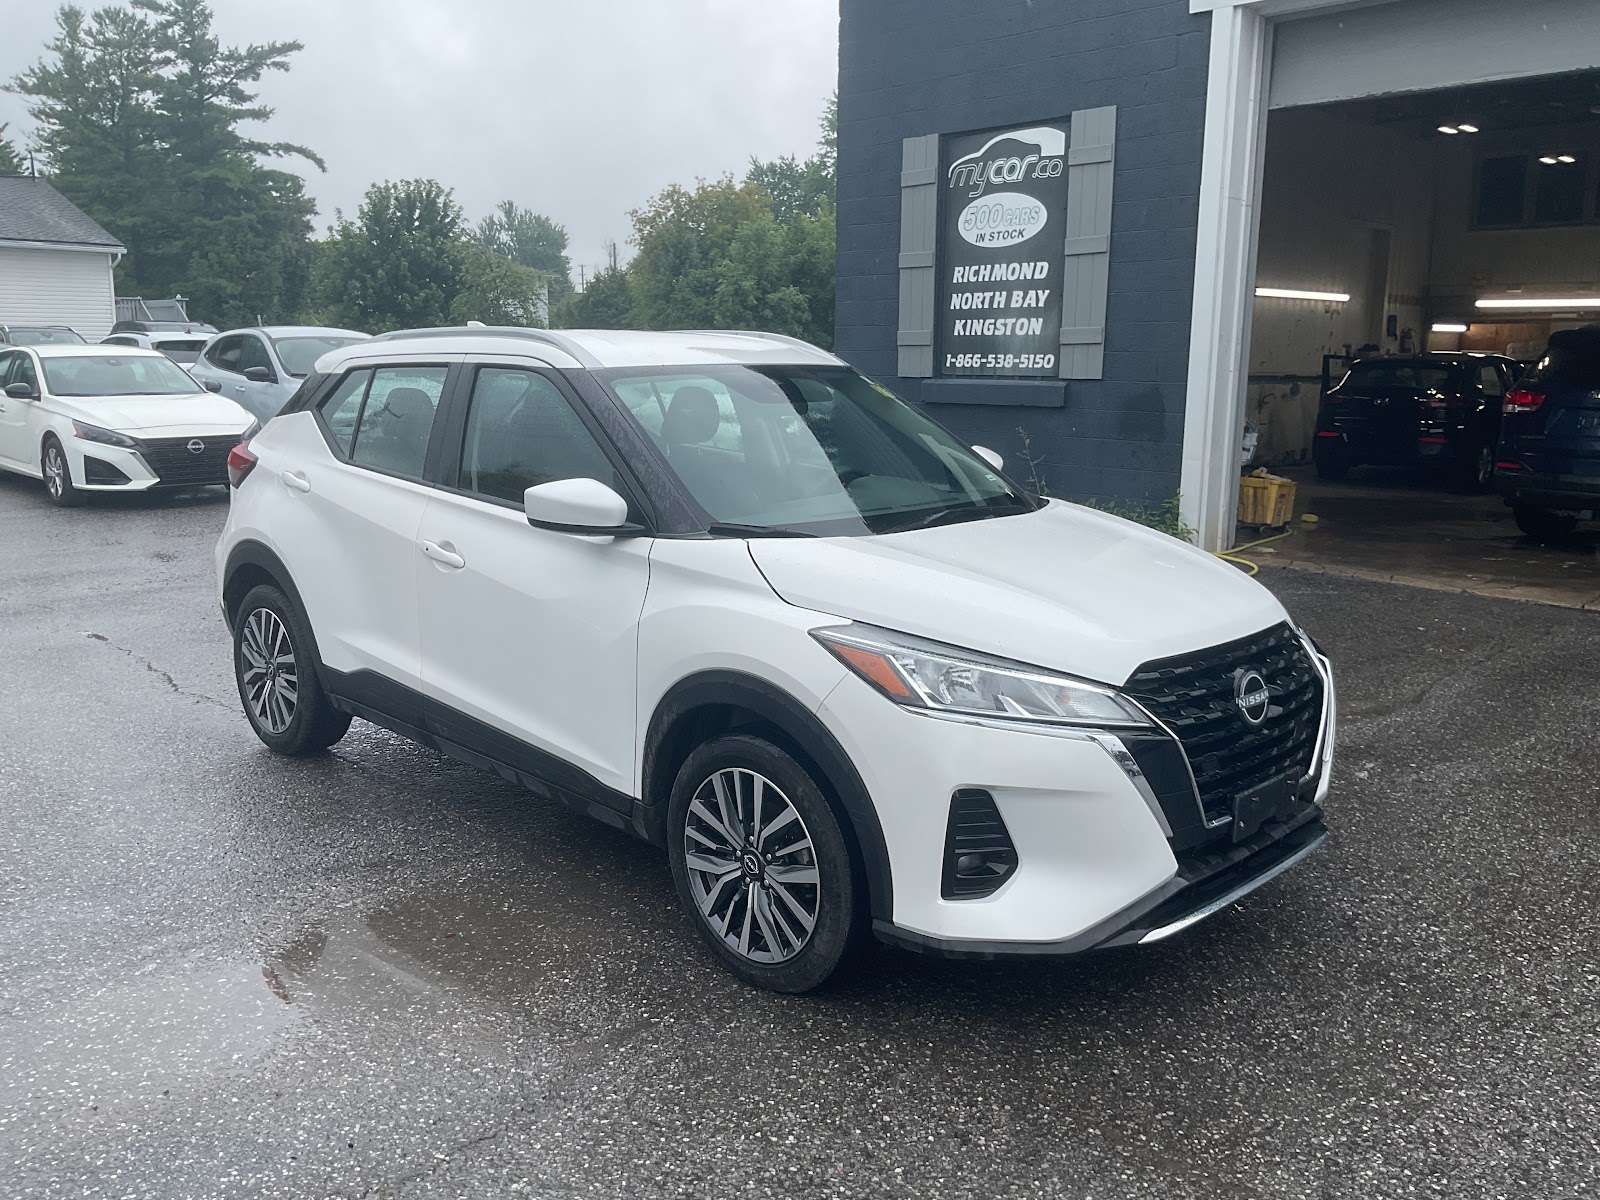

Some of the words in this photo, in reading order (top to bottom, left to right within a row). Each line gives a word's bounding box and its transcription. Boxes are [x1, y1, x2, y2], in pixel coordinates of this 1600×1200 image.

[949, 154, 1064, 197] mycar.co
[975, 233, 986, 243] IN
[988, 228, 1026, 242] STOCK
[952, 261, 1050, 284] RICHMOND
[950, 291, 1007, 310] NORTH
[1010, 289, 1050, 308] BAY
[953, 317, 1043, 336] KINGSTON
[945, 353, 1055, 369] 1-866-538-5150
[1238, 689, 1269, 708] NISSAN
